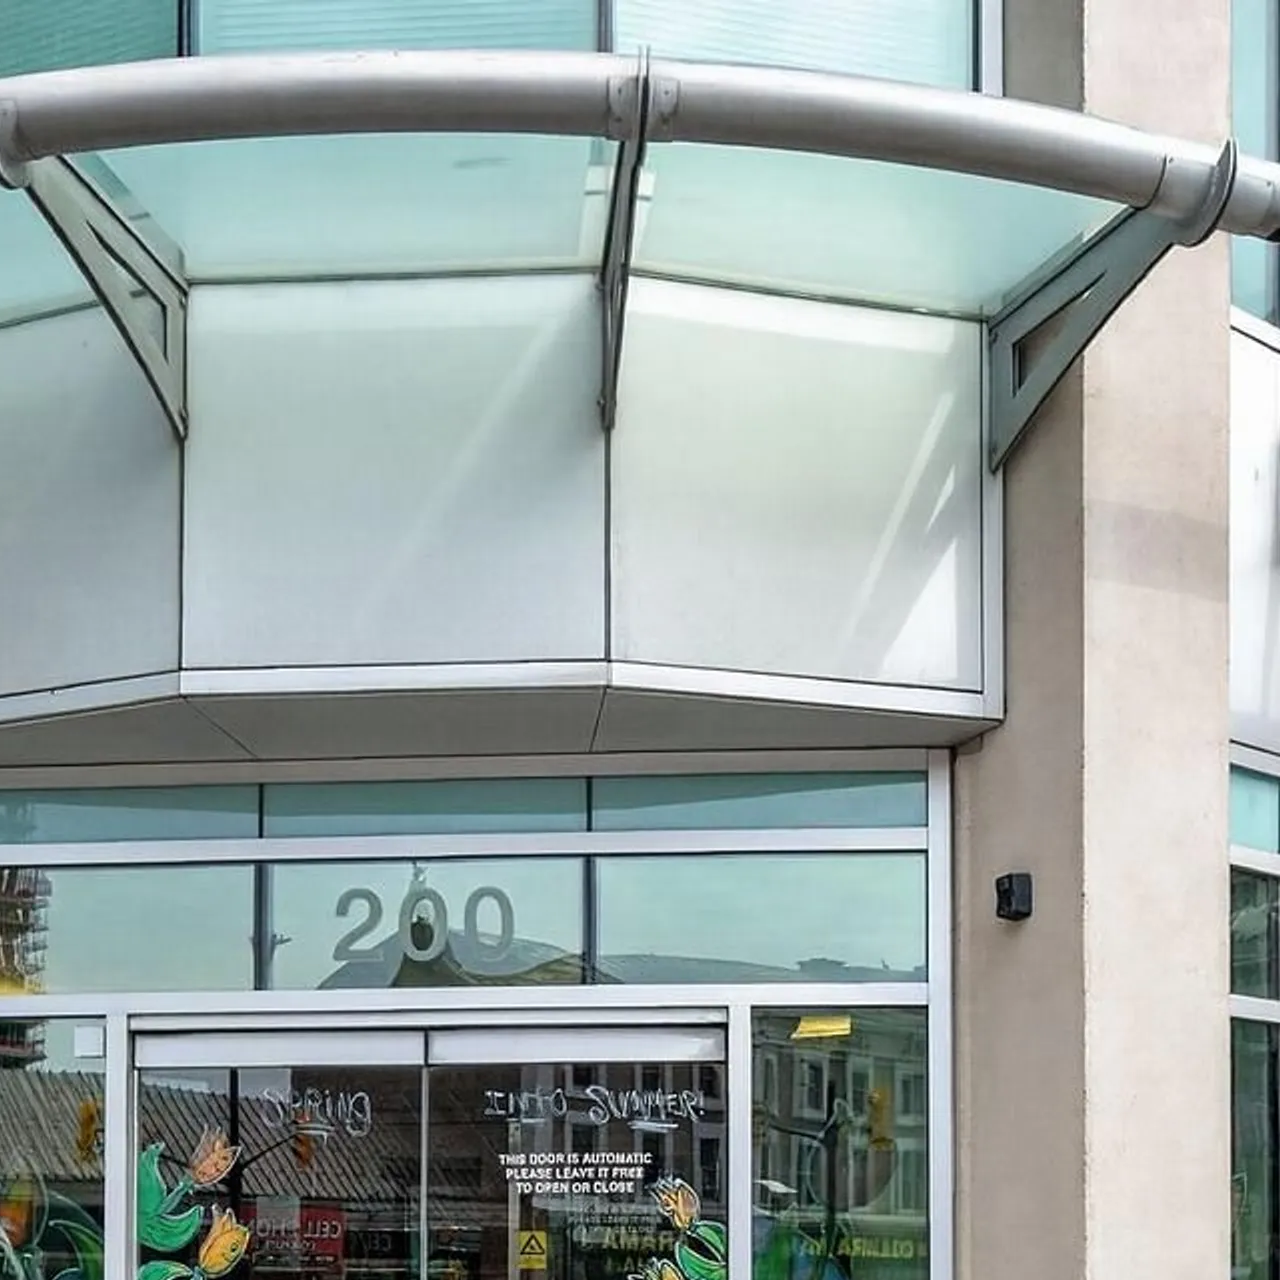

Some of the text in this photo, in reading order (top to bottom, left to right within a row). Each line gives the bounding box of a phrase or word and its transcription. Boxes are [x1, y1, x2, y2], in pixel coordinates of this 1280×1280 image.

[333, 886, 515, 962] 200
[498, 1152, 653, 1165] THIS DOOR IS AUTOMATIC
[505, 1166, 645, 1180] PLEASE LEAVE IT FREE
[516, 1181, 635, 1194] TO OPEN OR CLOSE
